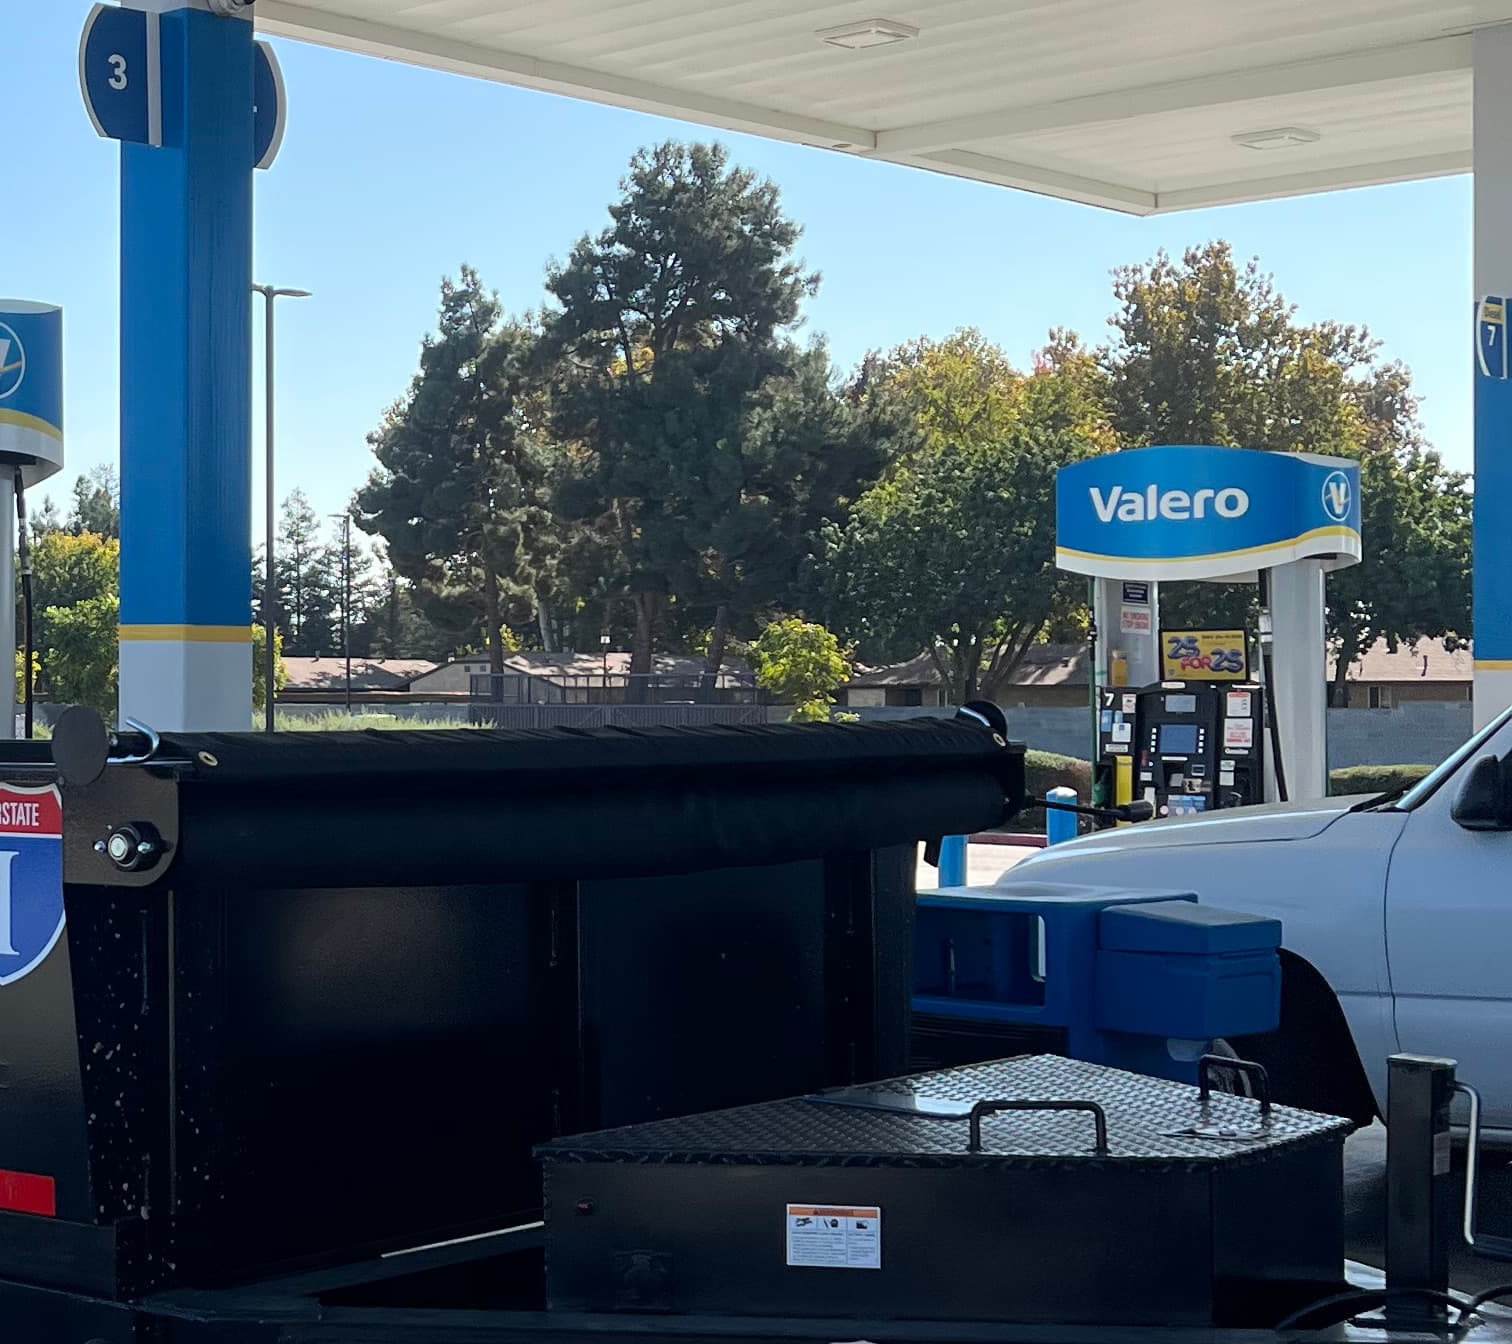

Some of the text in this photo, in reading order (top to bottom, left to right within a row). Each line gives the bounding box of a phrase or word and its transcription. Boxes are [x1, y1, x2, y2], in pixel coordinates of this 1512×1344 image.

[108, 54, 127, 90] 3
[1487, 325, 1497, 346] 7
[1089, 484, 1249, 523] Valero
[1168, 636, 1200, 659] 25
[1180, 656, 1212, 671] FOR
[1210, 649, 1243, 673] 25
[1104, 693, 1114, 706] 7
